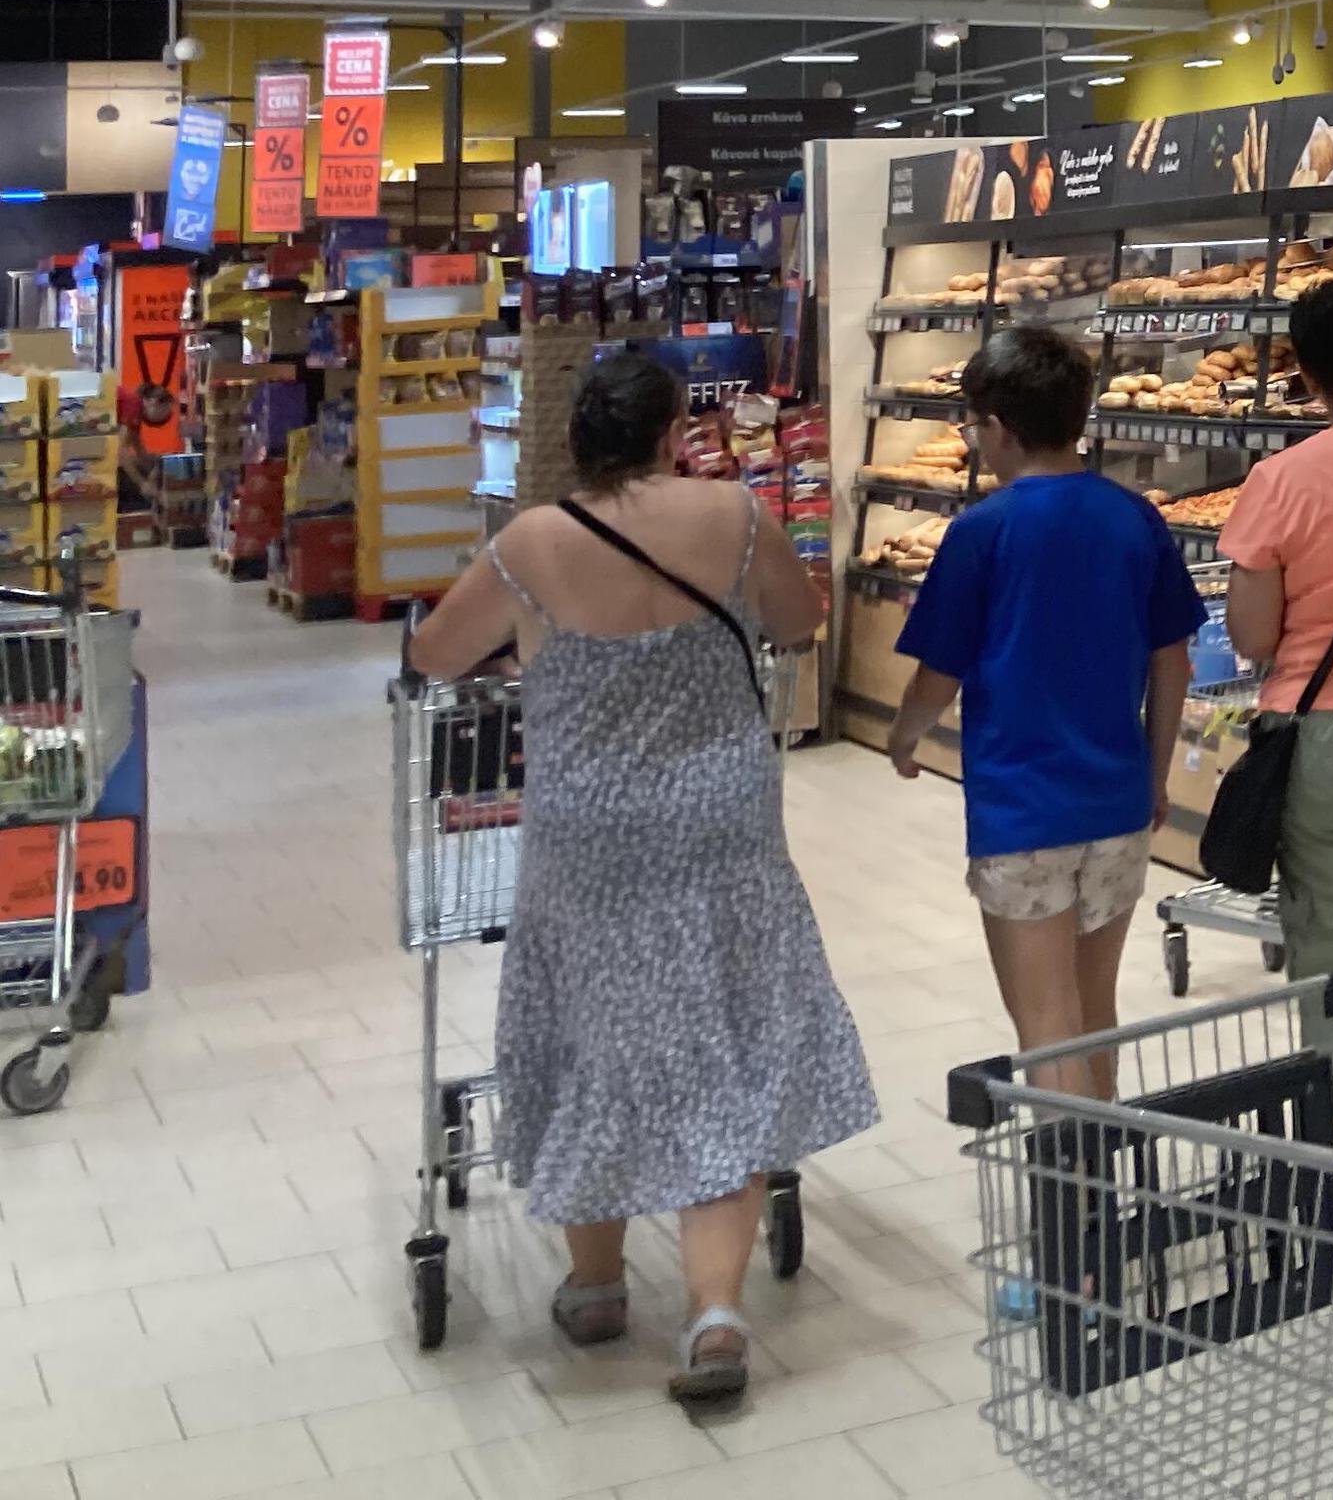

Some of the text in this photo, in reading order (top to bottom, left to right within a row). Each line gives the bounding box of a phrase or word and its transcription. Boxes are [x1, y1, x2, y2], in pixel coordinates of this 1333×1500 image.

[336, 59, 372, 74] CENA
[712, 110, 803, 124] Káva zrnková
[335, 105, 369, 148] %
[266, 135, 294, 173] %
[711, 148, 760, 160] Kávové
[326, 165, 374, 179] TENTO
[257, 186, 297, 199] TENTO
[323, 182, 372, 198] NÁKUP
